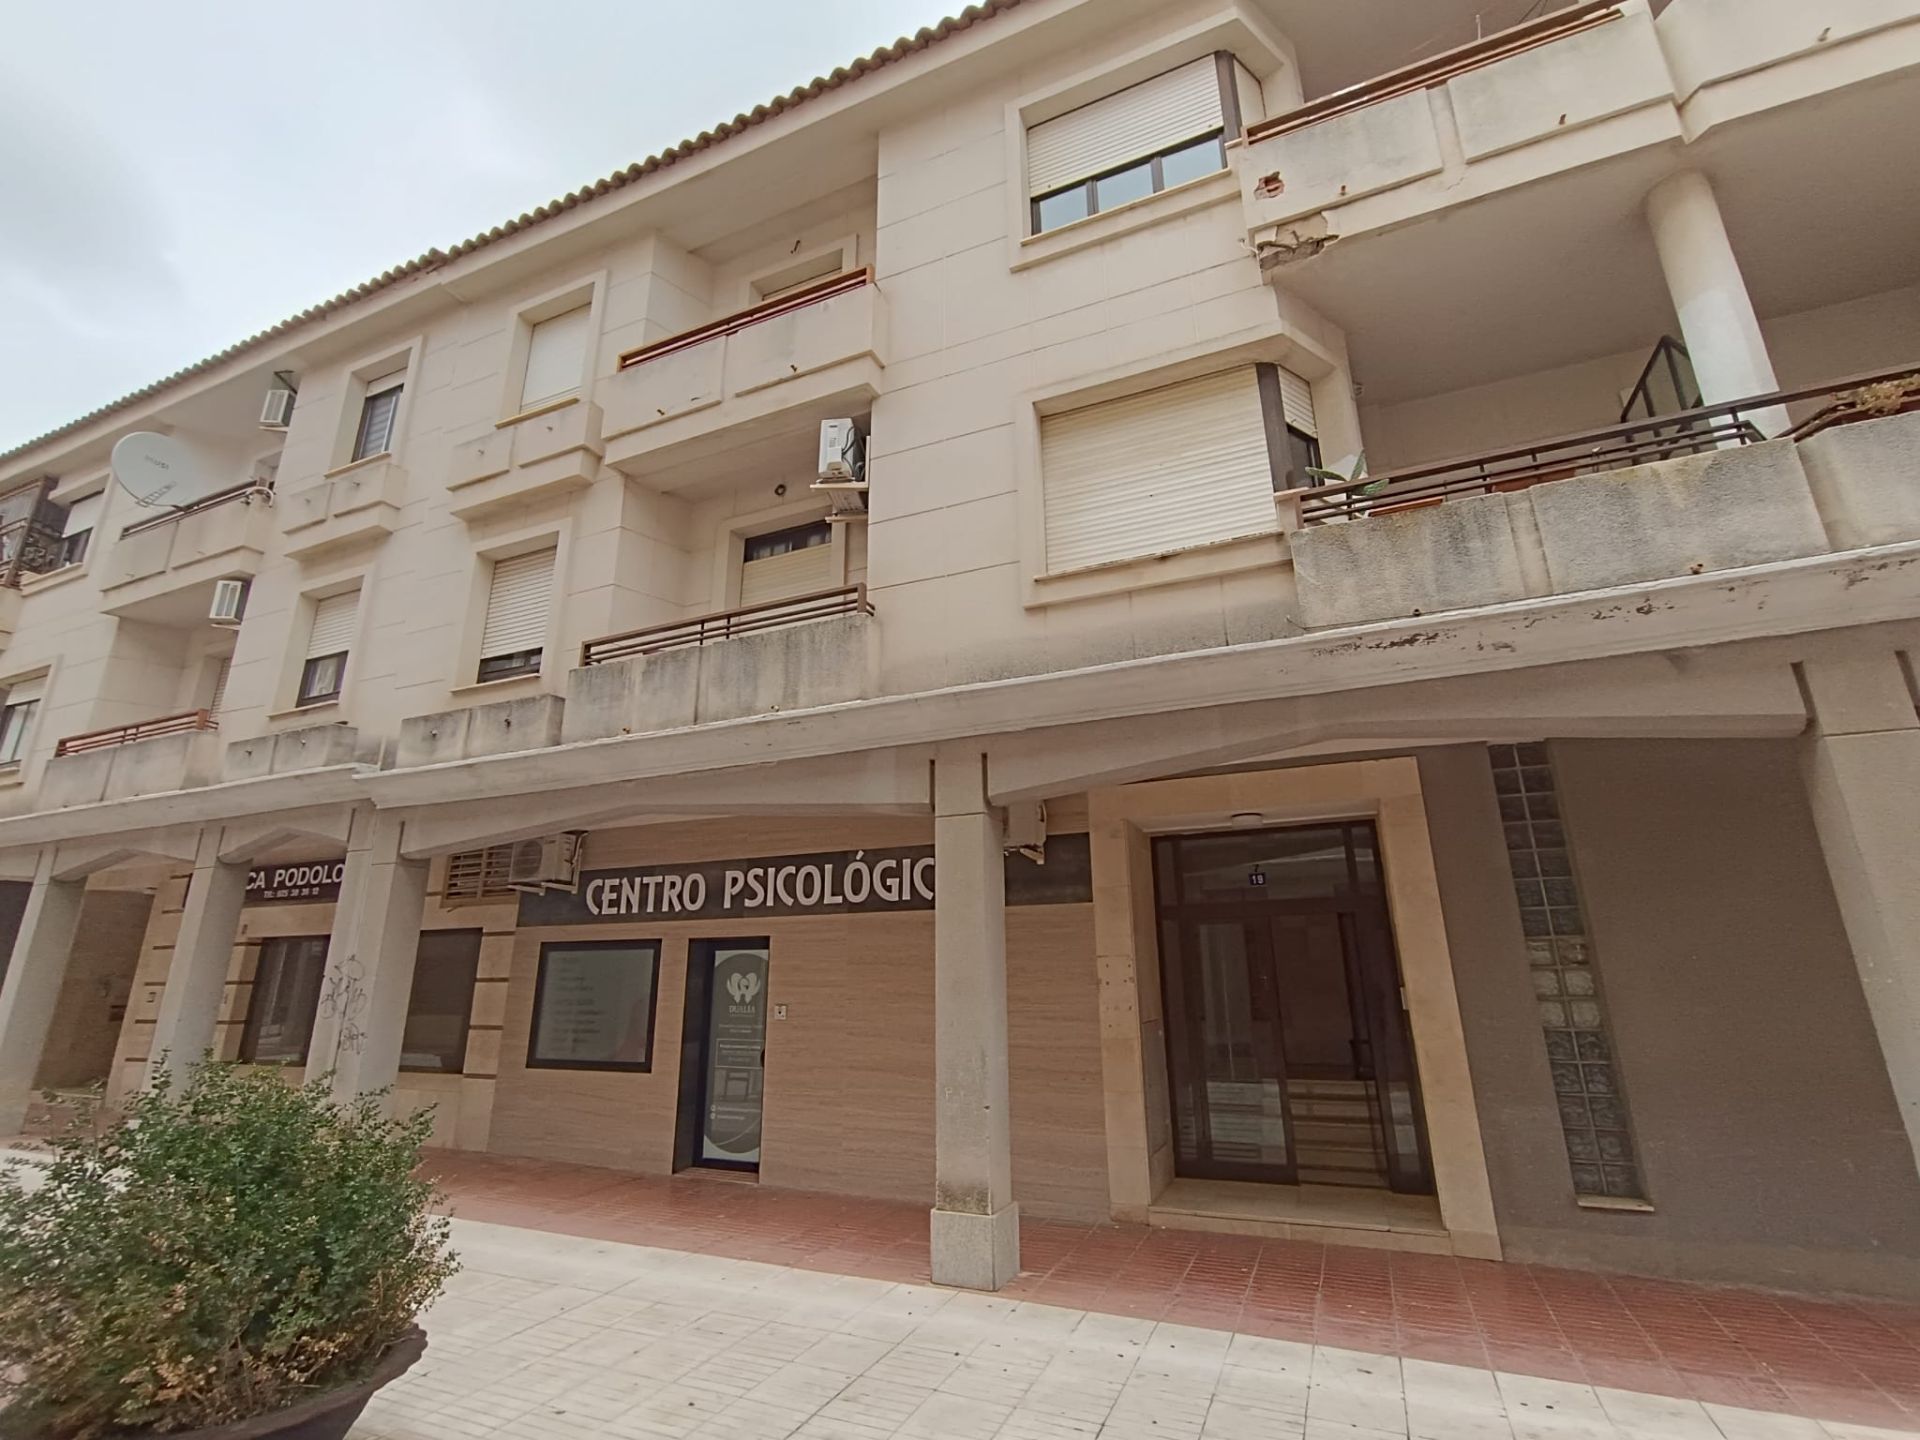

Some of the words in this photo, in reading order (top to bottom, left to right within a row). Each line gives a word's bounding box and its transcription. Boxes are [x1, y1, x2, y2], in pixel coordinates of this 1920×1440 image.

[273, 864, 345, 887] PODOLO
[586, 873, 706, 915] CENTRO
[723, 850, 935, 909] PSICOLÓGIC
